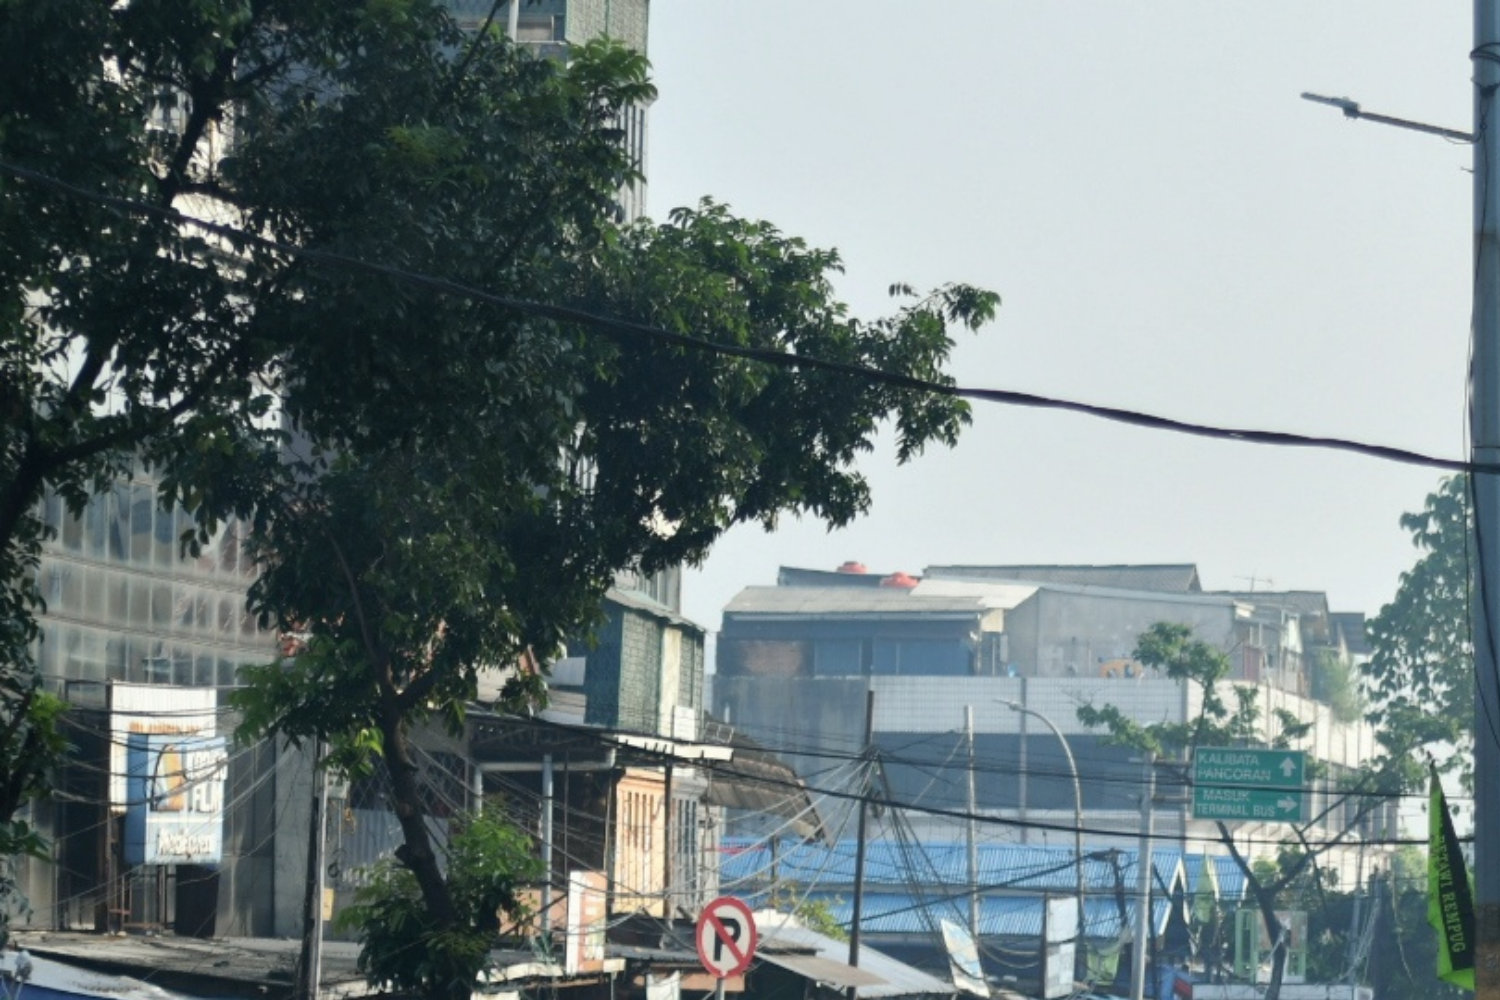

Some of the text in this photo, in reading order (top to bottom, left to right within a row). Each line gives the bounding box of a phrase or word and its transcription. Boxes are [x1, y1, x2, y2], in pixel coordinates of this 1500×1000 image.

[1199, 753, 1259, 765] KALIBATA
[1198, 768, 1271, 780] PANCORAN
[1203, 790, 1250, 801] MASUK
[1196, 803, 1275, 817] TERMINAL BUS
[1442, 892, 1466, 953] REMPUG
